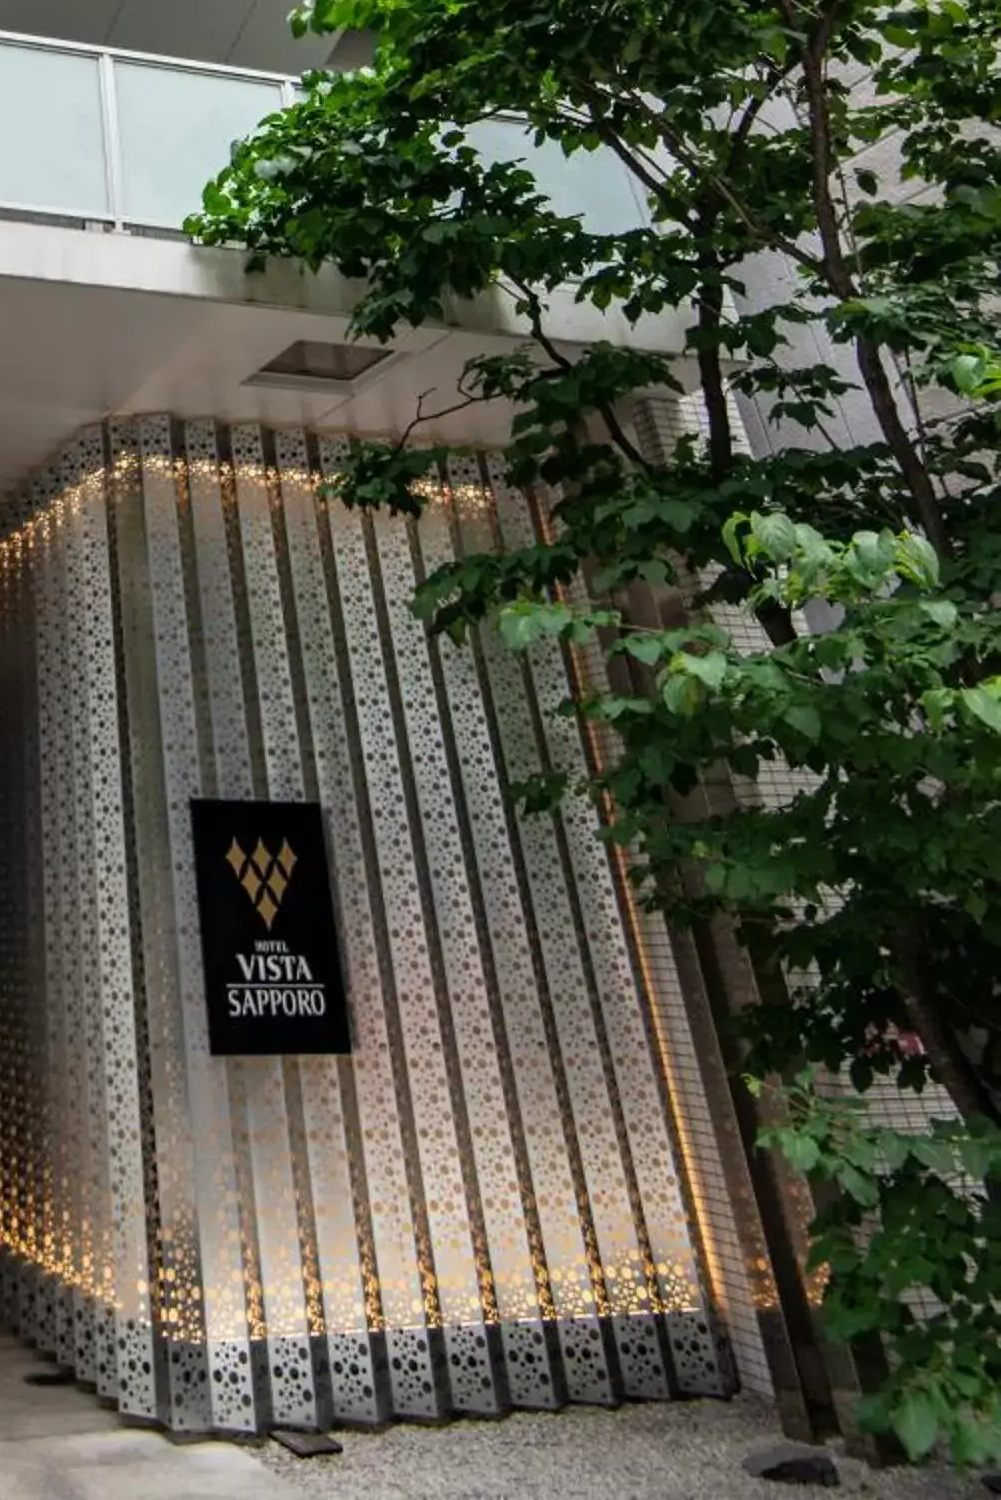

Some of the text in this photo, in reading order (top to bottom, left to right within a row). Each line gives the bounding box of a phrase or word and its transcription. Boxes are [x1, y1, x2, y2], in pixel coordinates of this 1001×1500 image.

[254, 940, 290, 953] HOTEL
[235, 954, 313, 981] VISTA
[228, 989, 326, 1017] SAPPORO
